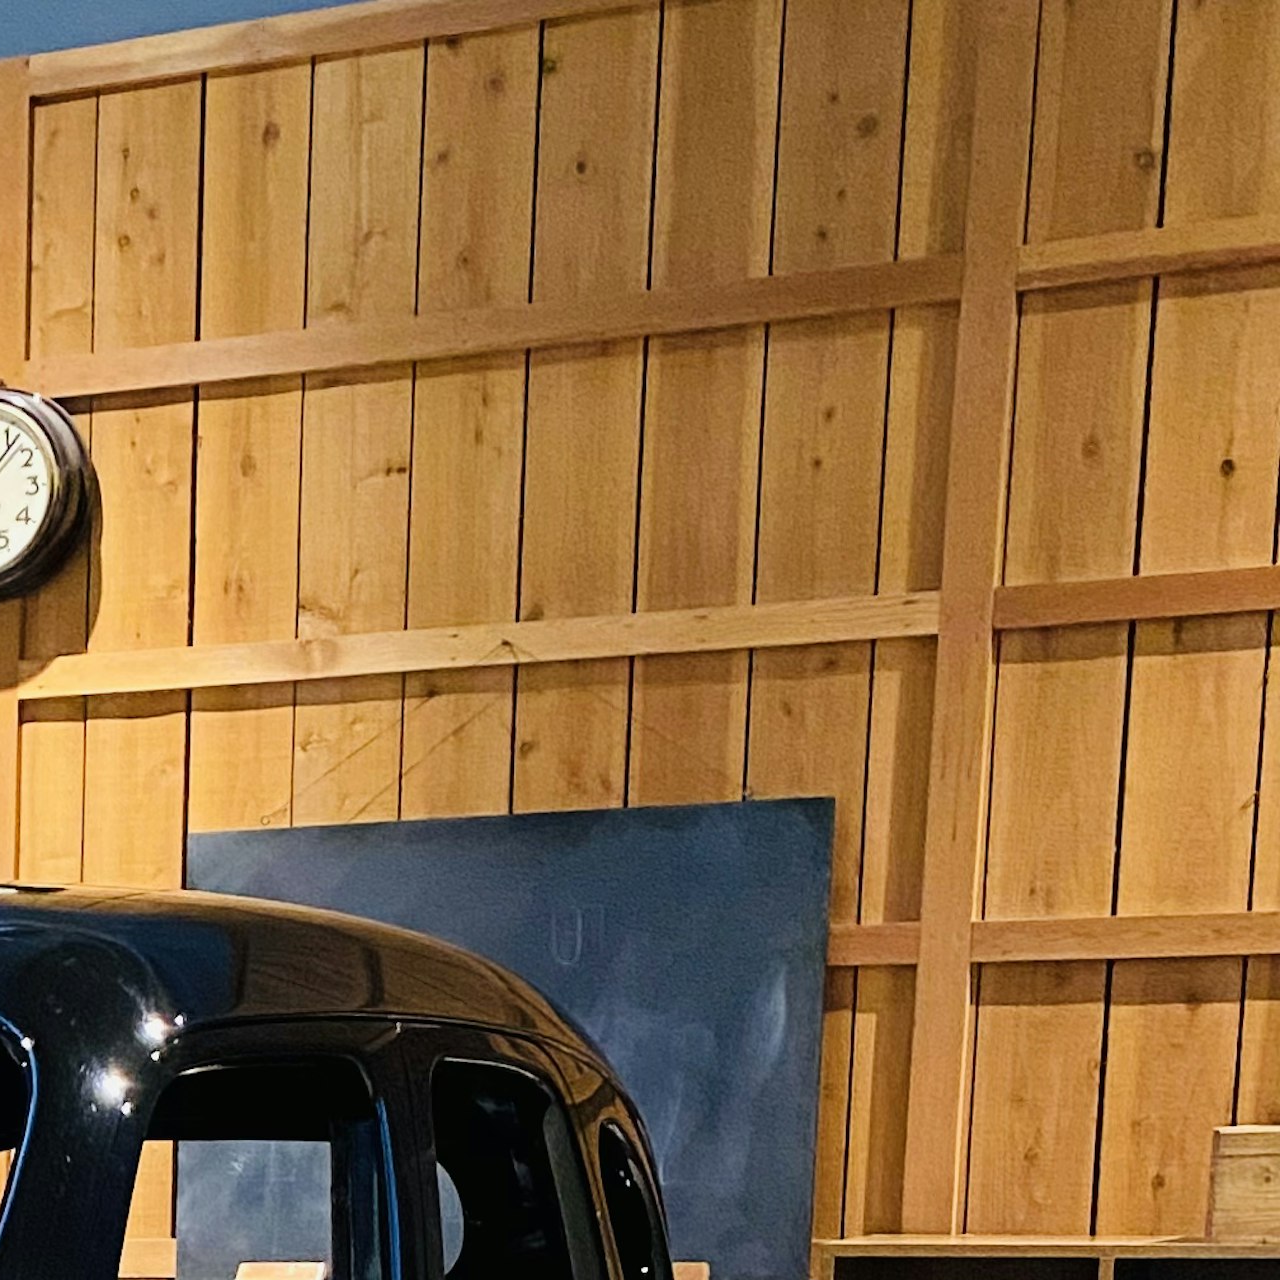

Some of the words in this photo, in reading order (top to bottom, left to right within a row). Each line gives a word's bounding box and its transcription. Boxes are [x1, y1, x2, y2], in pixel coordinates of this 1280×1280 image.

[21, 448, 33, 467] 2
[25, 476, 39, 496] 3
[16, 506, 31, 525] 4
